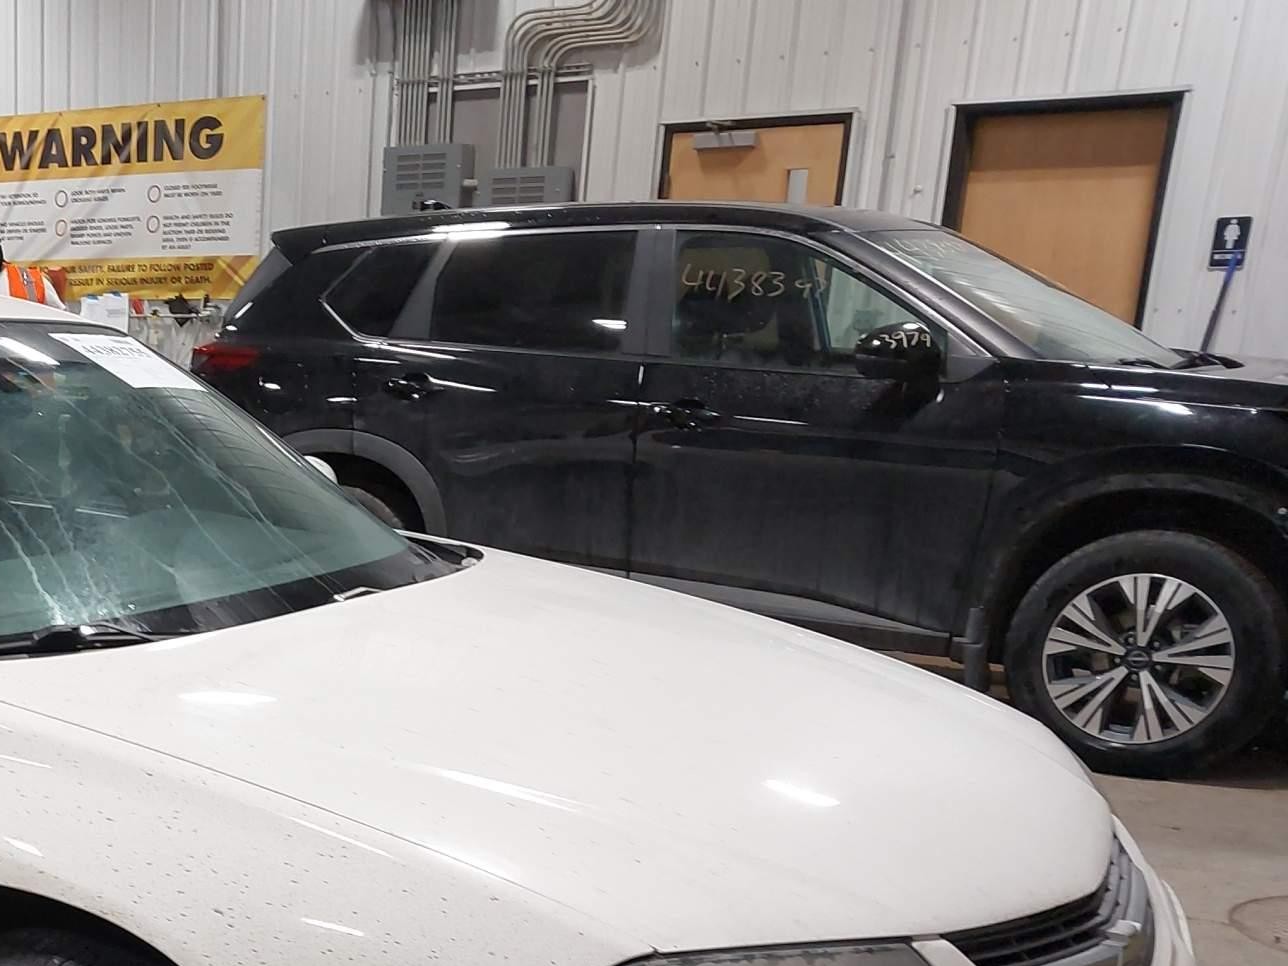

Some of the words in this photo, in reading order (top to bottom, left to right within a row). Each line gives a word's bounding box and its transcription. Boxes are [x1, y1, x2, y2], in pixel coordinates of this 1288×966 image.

[107, 263, 135, 273] FAILURE
[137, 263, 148, 272] TO
[149, 263, 181, 272] FOLLOW
[184, 262, 215, 271] POSTED
[95, 278, 105, 286] IN
[139, 276, 169, 285] INJURY
[170, 276, 181, 284] OR
